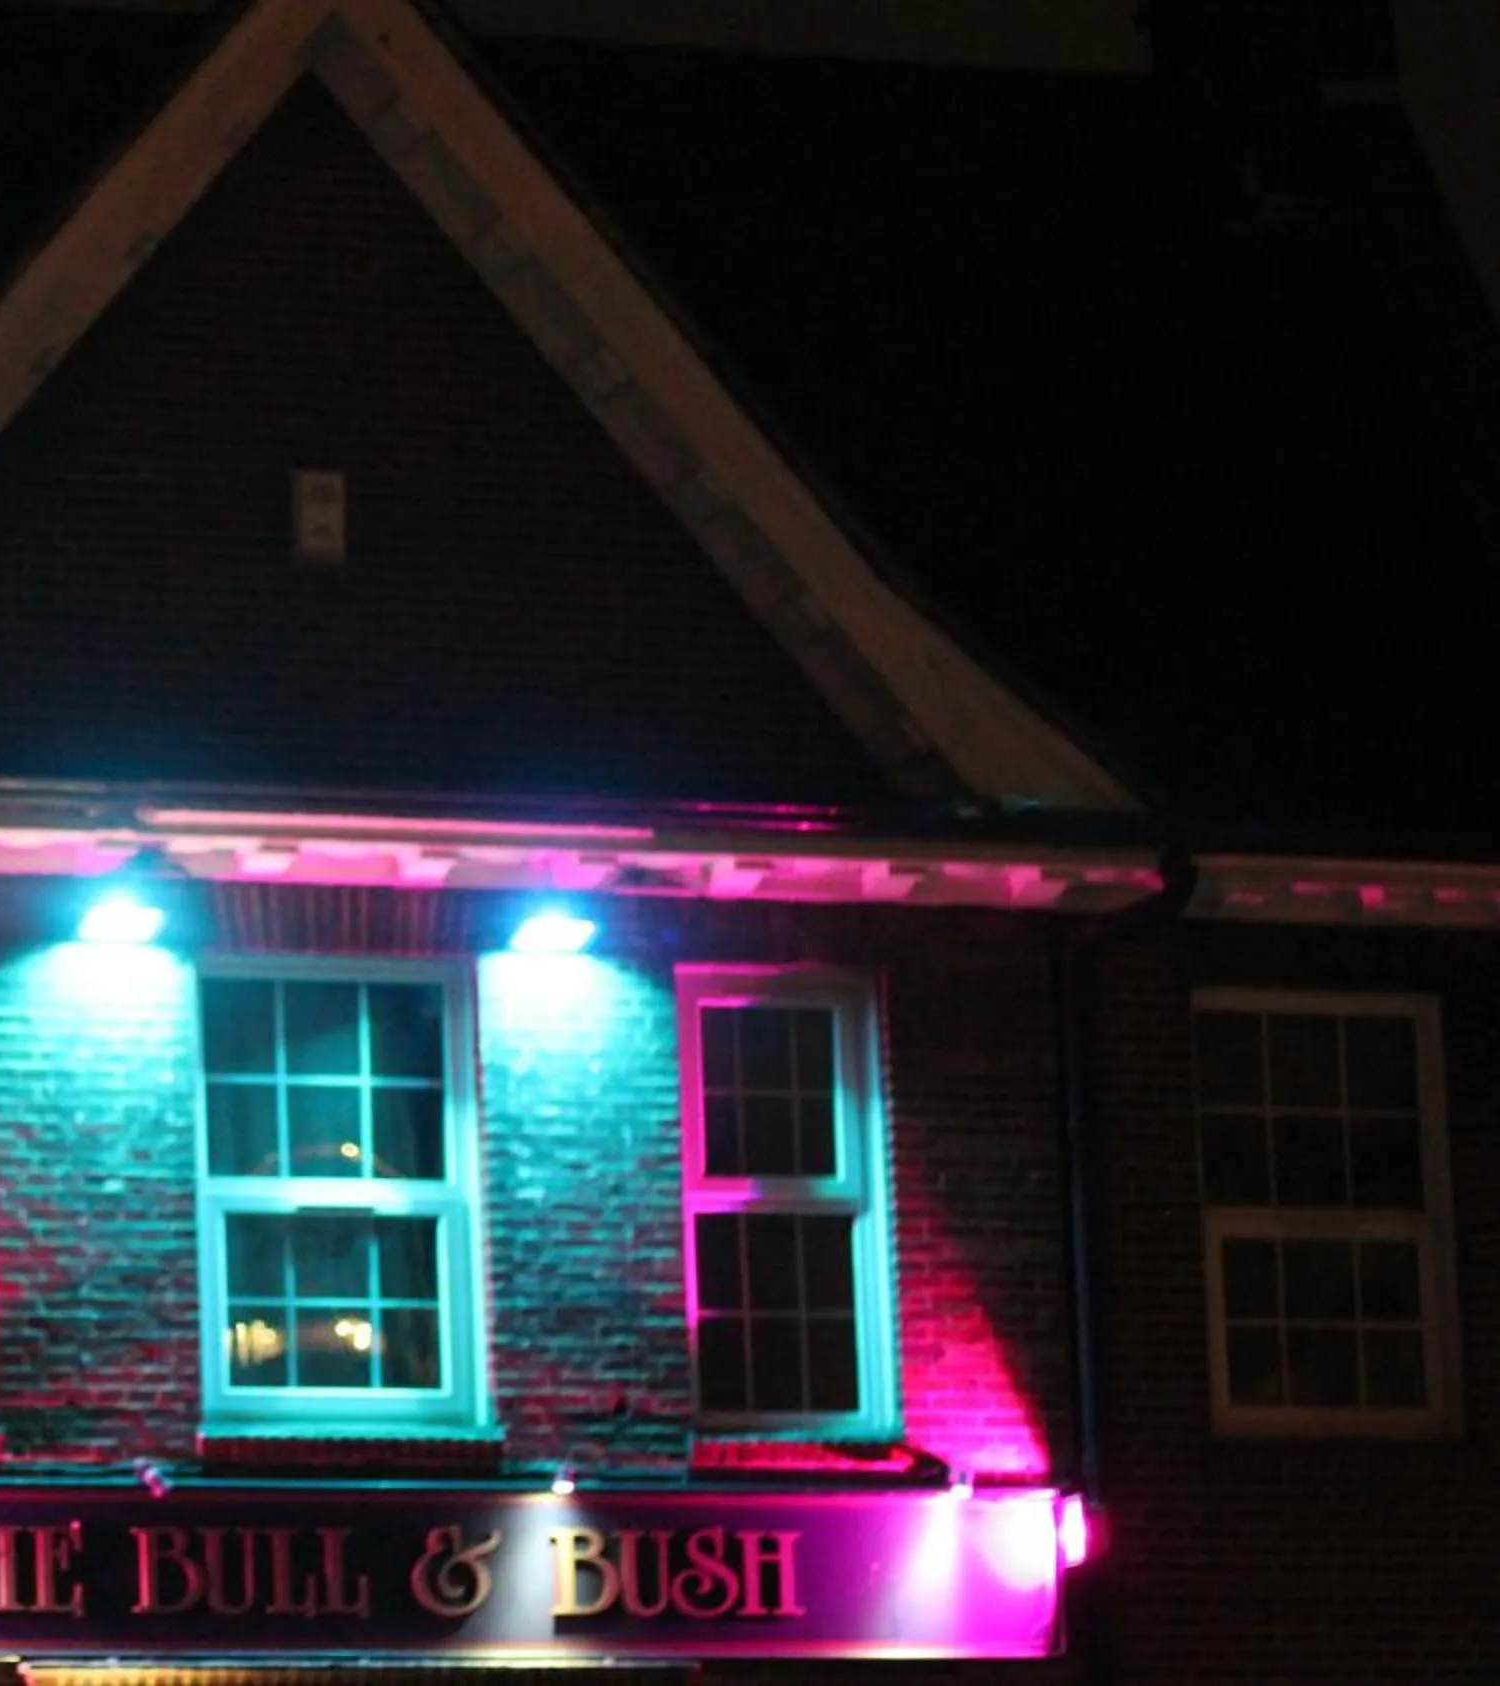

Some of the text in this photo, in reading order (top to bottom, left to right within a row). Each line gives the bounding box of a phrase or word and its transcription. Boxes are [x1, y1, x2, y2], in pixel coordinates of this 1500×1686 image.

[130, 1526, 369, 1617] BULL
[411, 1524, 500, 1618] &
[550, 1526, 804, 1619] BUSH
